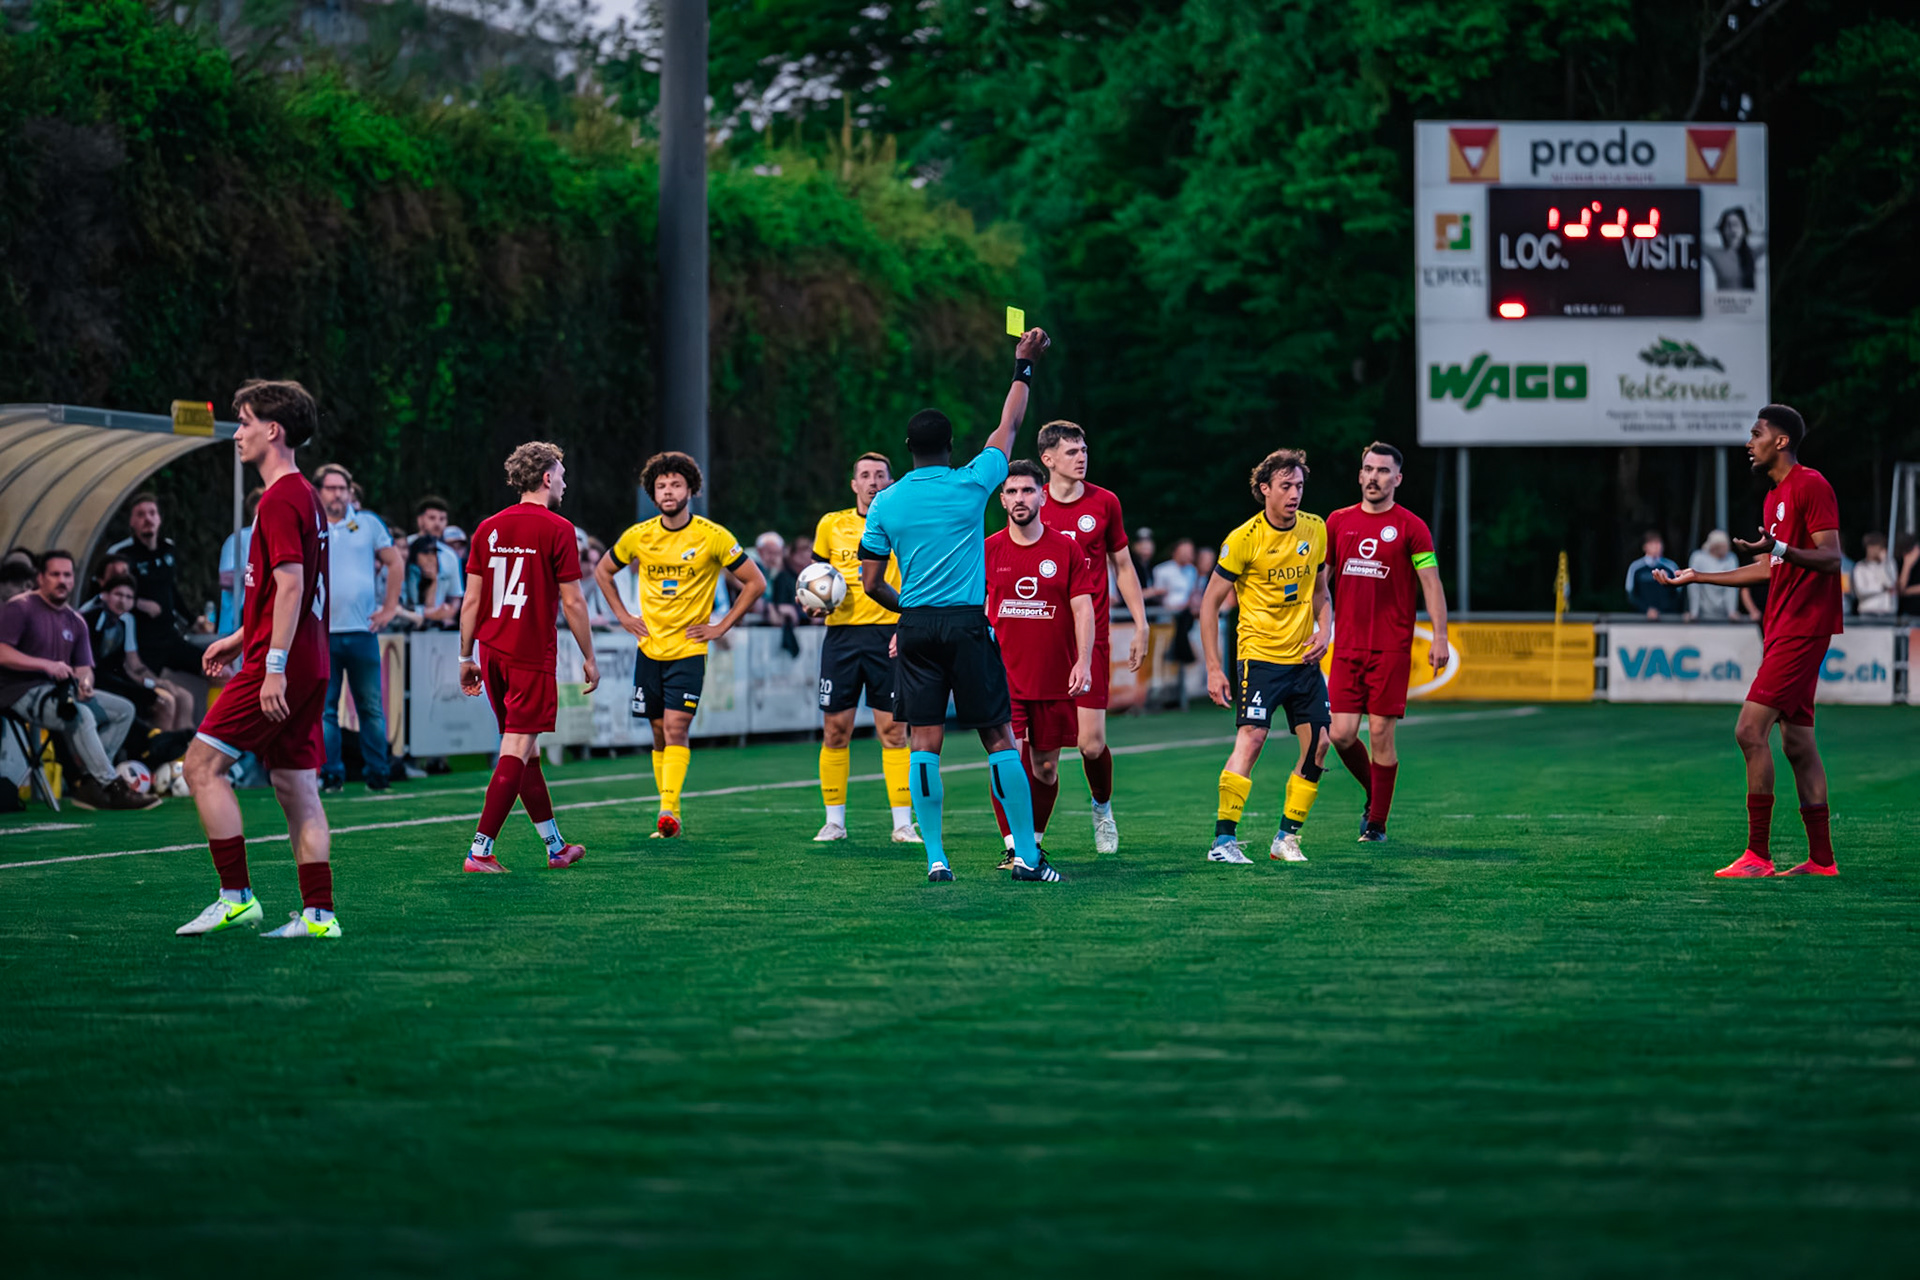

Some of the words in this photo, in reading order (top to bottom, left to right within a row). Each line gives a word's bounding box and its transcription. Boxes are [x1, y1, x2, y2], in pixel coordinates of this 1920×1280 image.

[1530, 128, 1656, 176] prodo
[1499, 232, 1570, 270] LOC.
[1622, 234, 1698, 270] VISIT.
[1429, 353, 1588, 410] WAGO
[487, 556, 529, 619] 14
[1267, 564, 1311, 582] PADEA
[1002, 606, 1043, 617] Autosport
[1617, 645, 1741, 682] VAC.ch
[1818, 647, 1887, 682] C.ch
[820, 678, 833, 694] 20
[1251, 690, 1263, 707] 4
